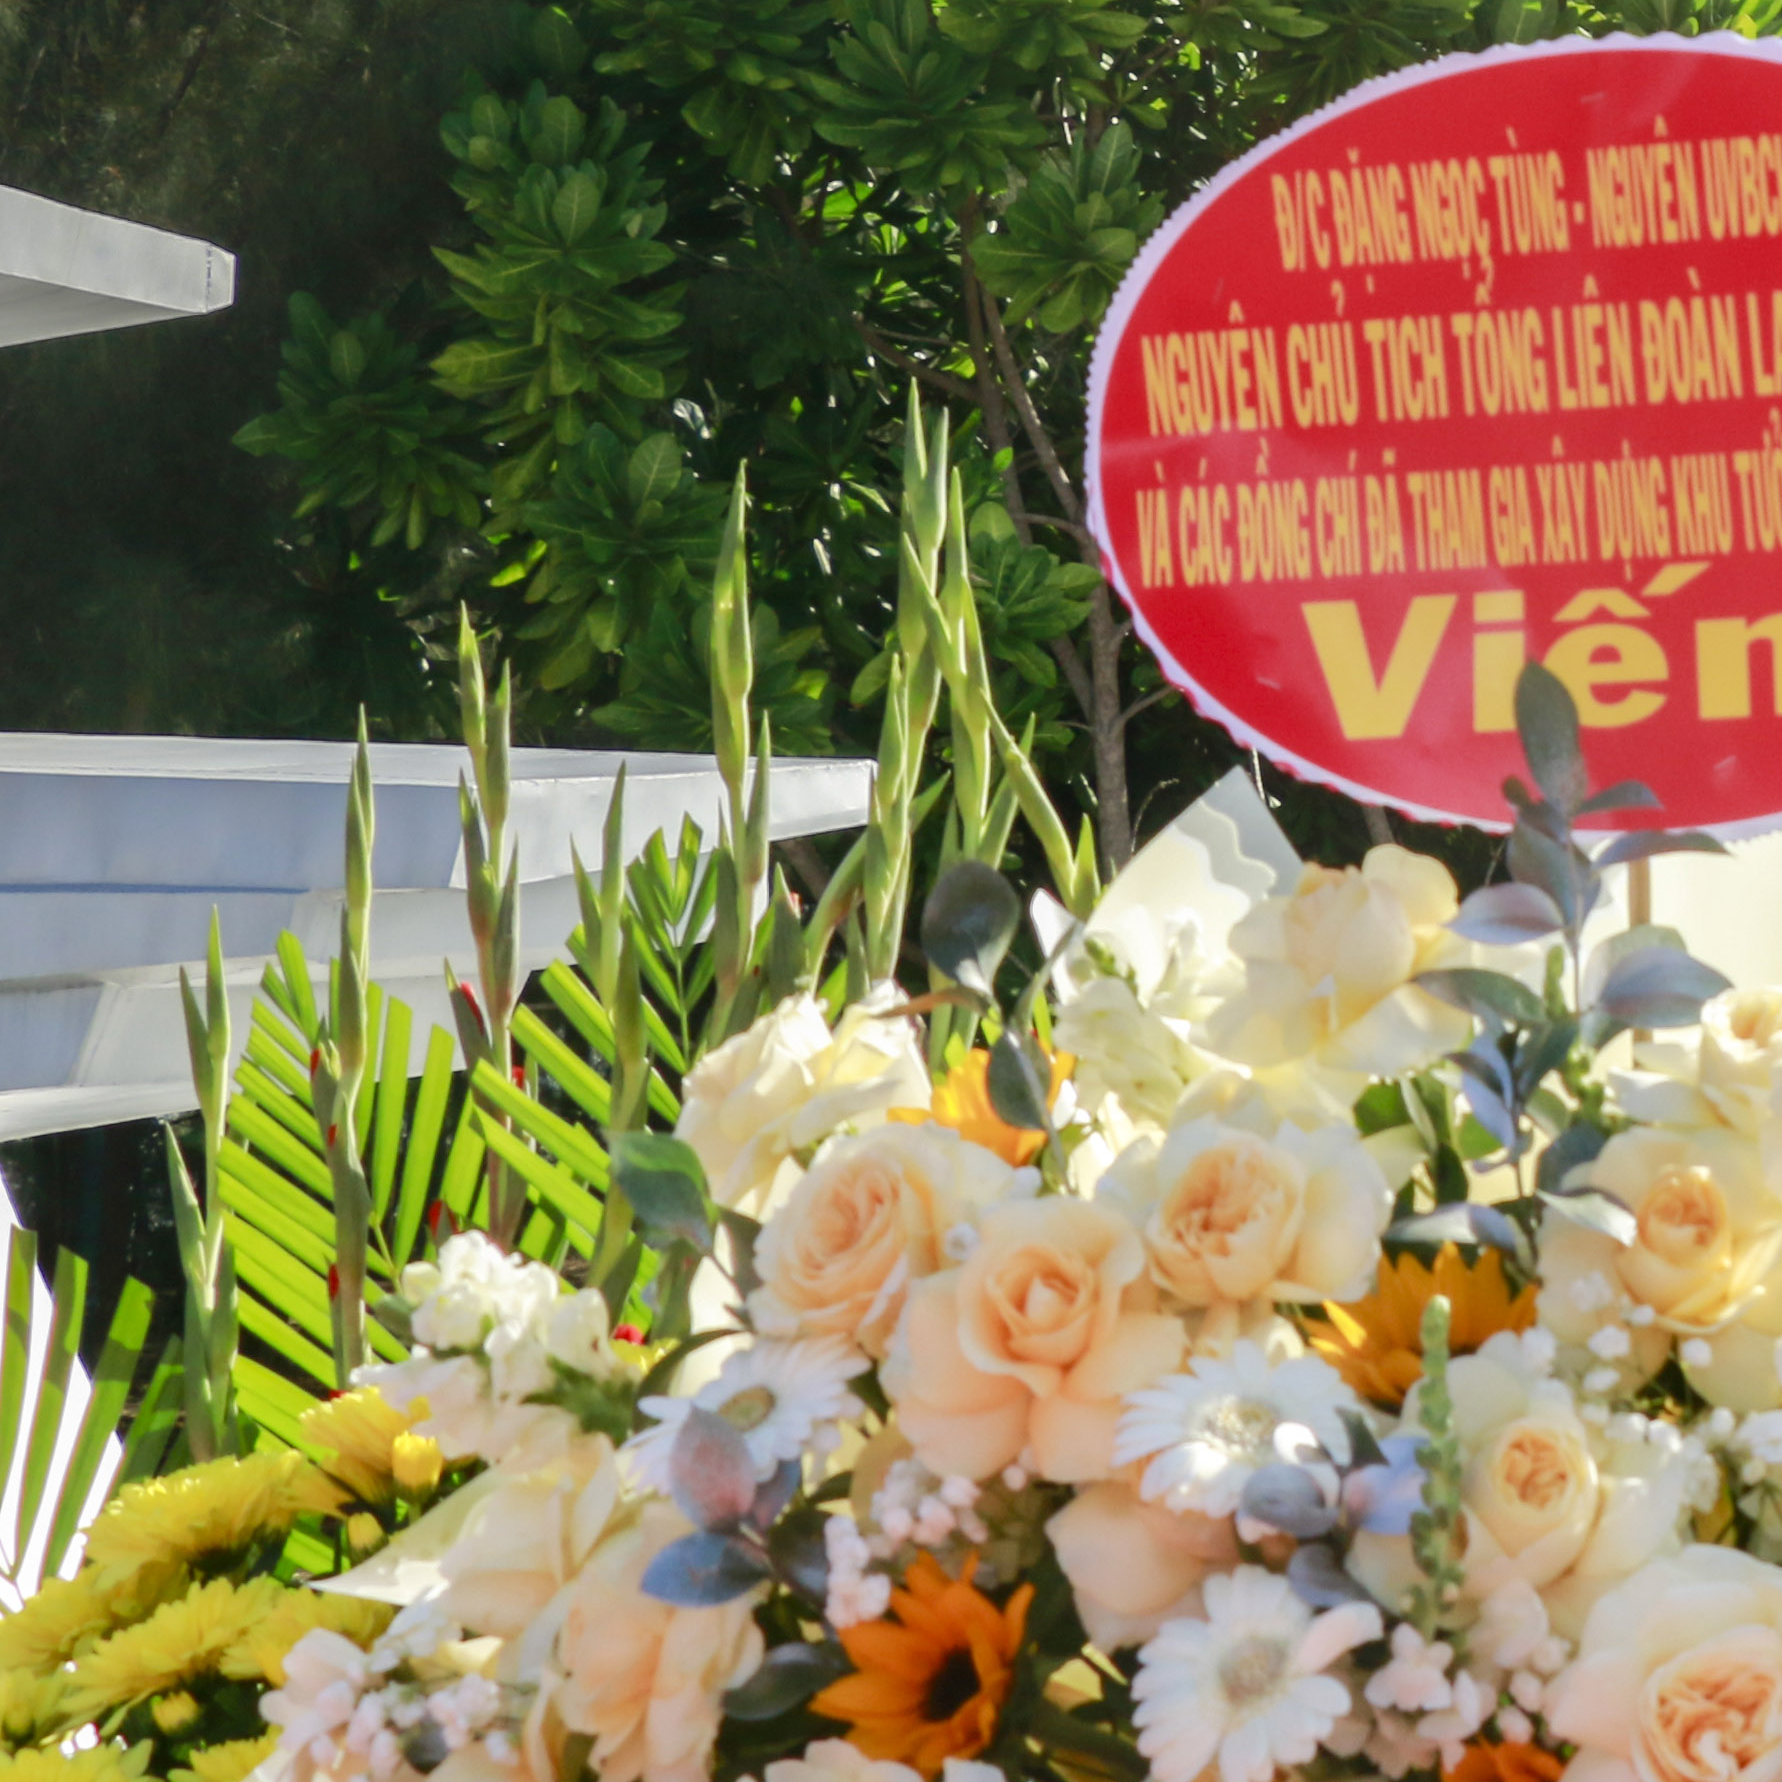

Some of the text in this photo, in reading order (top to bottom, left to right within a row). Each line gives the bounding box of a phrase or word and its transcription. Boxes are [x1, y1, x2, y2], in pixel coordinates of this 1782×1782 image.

[1271, 170, 1331, 271] Đ/C
[1410, 156, 1491, 280] NGỌC
[1488, 126, 1570, 255] TÙNG
[1586, 115, 1700, 248] NGUYÊN
[1141, 300, 1283, 438] NGUYÊN
[1286, 279, 1360, 429] CHỦ
[1451, 255, 1549, 417] TỔNG
[1552, 274, 1637, 409] LIÊN
[1640, 266, 1743, 405] ĐOÀN
[1135, 460, 1174, 589] VÀ
[1178, 457, 1233, 587] CÁC
[1237, 436, 1312, 583] ĐỒNG
[1315, 449, 1363, 578] CHÍ
[1365, 447, 1406, 575] ĐÃ
[1406, 468, 1488, 572] THAM
[1490, 464, 1537, 568] GIA
[1535, 435, 1589, 565] XÂY
[1594, 438, 1672, 582] DỰNG
[1671, 452, 1734, 557] KHU
